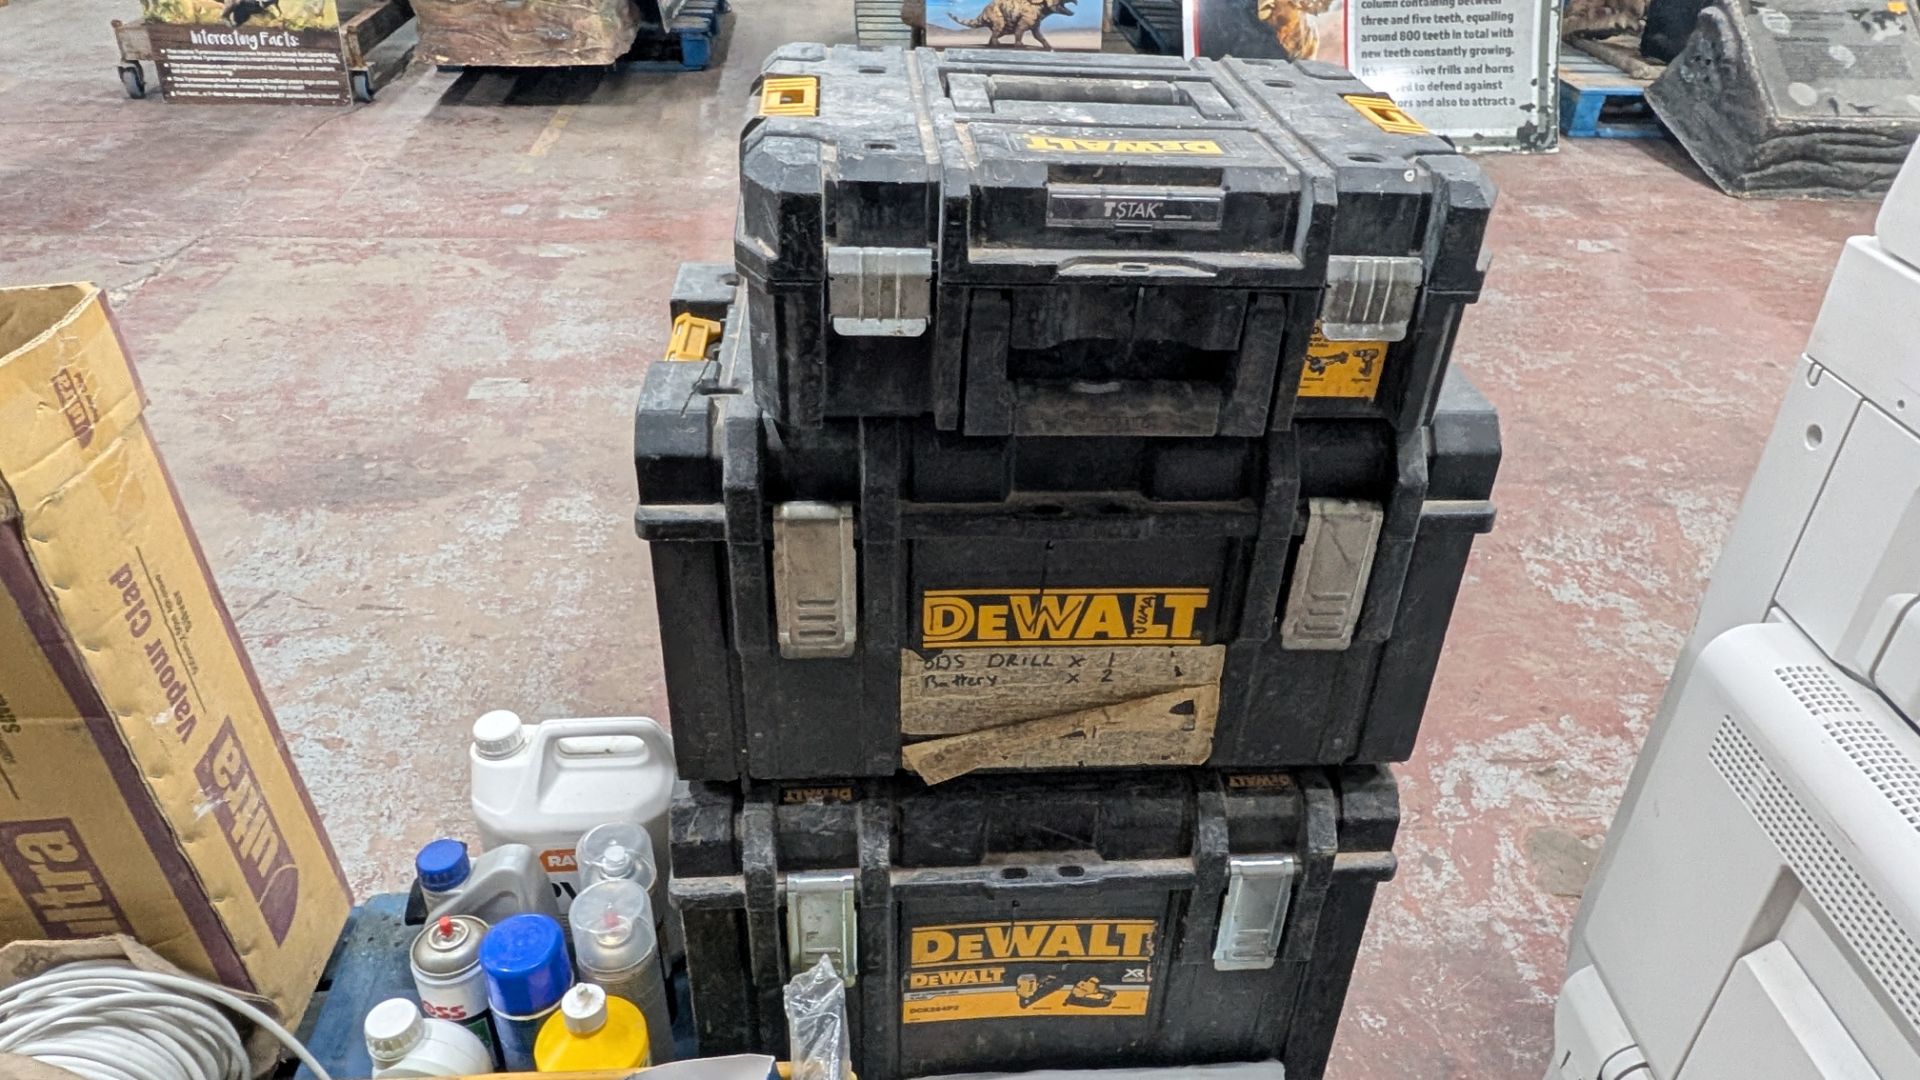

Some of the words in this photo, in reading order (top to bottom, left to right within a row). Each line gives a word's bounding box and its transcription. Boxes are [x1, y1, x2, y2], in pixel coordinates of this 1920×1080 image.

[1361, 0, 1398, 8] column
[1400, 0, 1455, 8] containing
[1361, 15, 1389, 25] three
[1391, 14, 1409, 24] and
[1412, 13, 1431, 24] five
[1434, 13, 1464, 24] teeth,
[1466, 11, 1514, 24] equalling
[190, 29, 258, 50] Interesting
[260, 31, 299, 47] Facts:
[1361, 31, 1397, 42] around
[1400, 30, 1420, 41] 800
[1423, 29, 1450, 40] teeth
[1452, 29, 1461, 39] in
[1464, 28, 1489, 39] total
[1491, 27, 1514, 38] with
[1361, 50, 1380, 59] new
[1383, 48, 1411, 58] teeth
[1413, 45, 1467, 58] constantly
[1469, 45, 1514, 58] growing.
[1437, 64, 1461, 75] frills
[1464, 64, 1482, 74] and
[1485, 64, 1514, 73] horns
[1415, 83, 1425, 91] to
[1427, 81, 1462, 91] defend
[1464, 80, 1503, 93] against
[1416, 98, 1434, 107] and
[1436, 97, 1457, 107] also
[1459, 98, 1470, 106] to
[1472, 97, 1508, 106] attract
[108, 563, 151, 639] Clad
[922, 593, 1208, 641] DEWALT
[986, 653, 1054, 669] DRILL
[924, 673, 997, 689] Battery
[1101, 668, 1113, 683] 2
[144, 638, 197, 745] Vapour
[213, 732, 279, 878] ultra
[911, 924, 1150, 964] DEWALT
[909, 968, 1004, 988] DEWALT
